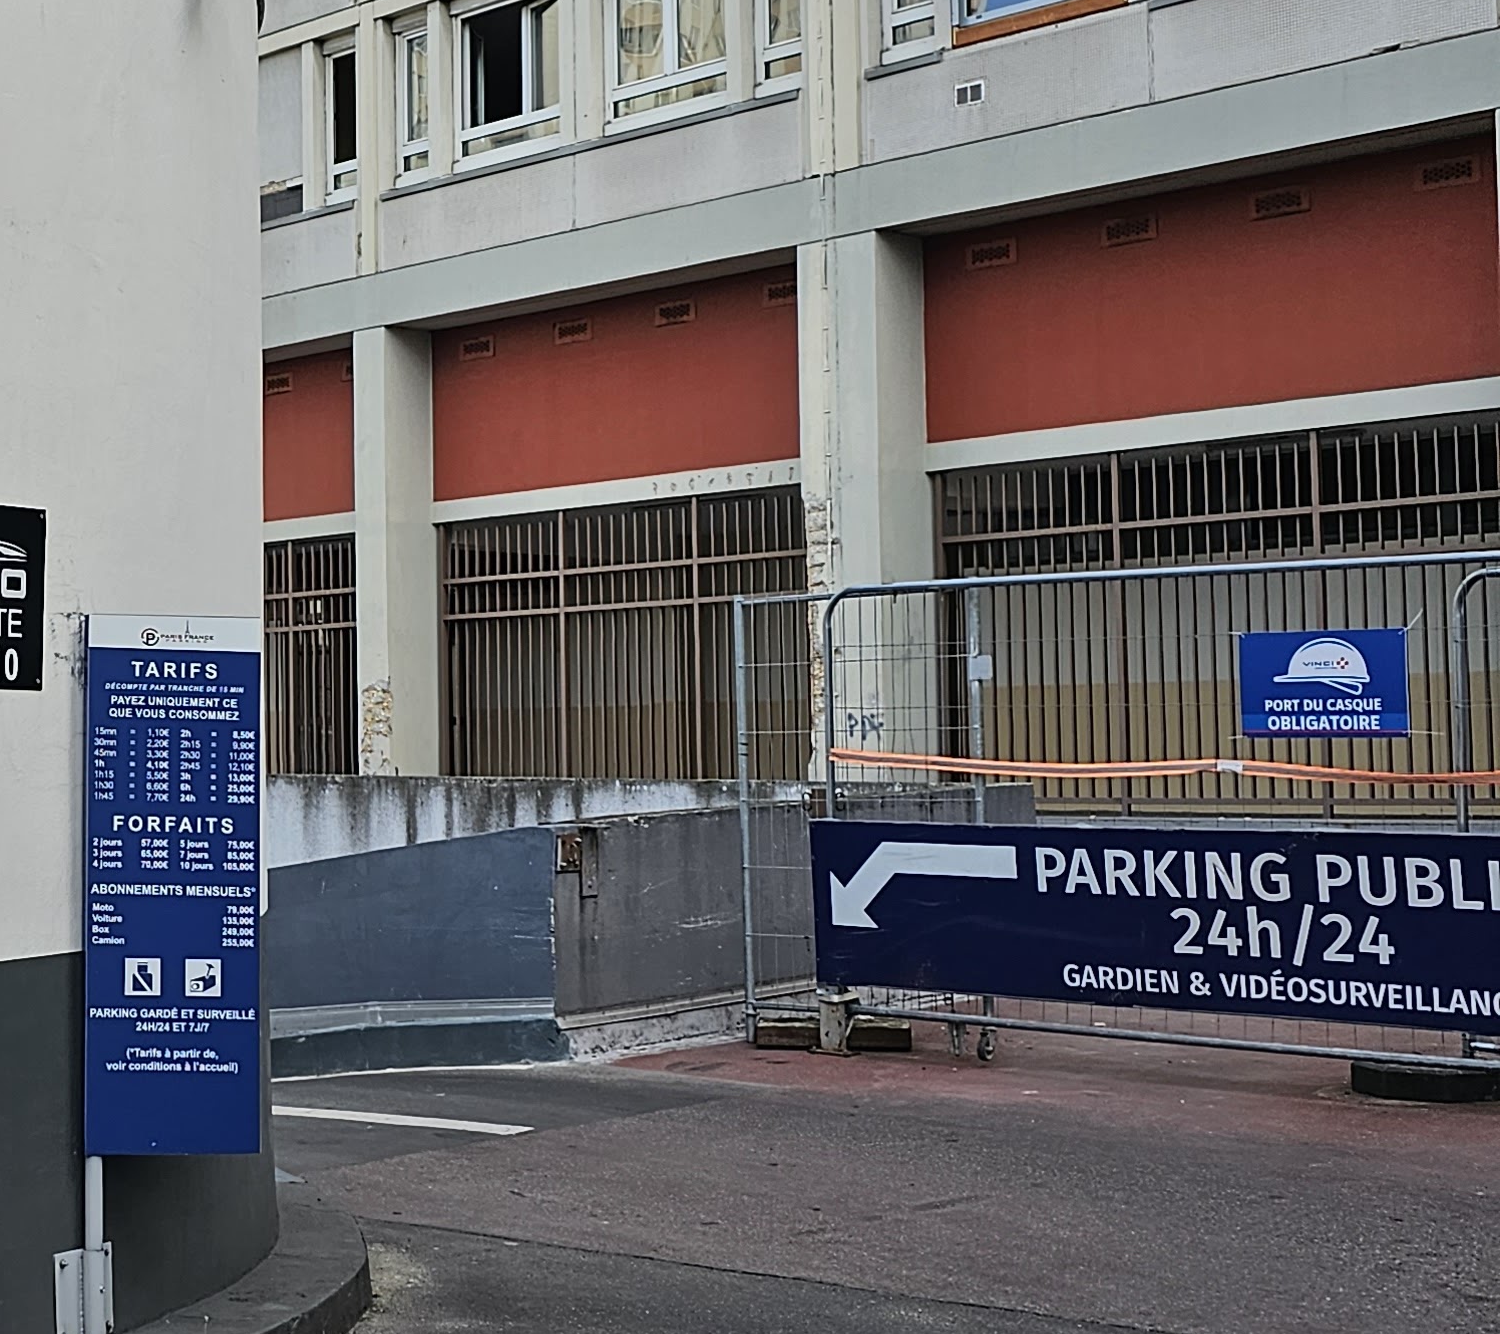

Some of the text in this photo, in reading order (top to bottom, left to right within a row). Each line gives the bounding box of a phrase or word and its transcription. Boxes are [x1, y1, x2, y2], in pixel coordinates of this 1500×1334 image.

[131, 661, 218, 680] TARIFS
[104, 682, 148, 691] DÉCOMPTE
[167, 684, 204, 693] TRANCHE
[229, 686, 244, 694] MIN
[110, 695, 238, 709] PAYEZ UNIQUEMENT CE
[1264, 698, 1382, 712] PORT DU CASQUE
[109, 707, 240, 721] QUE VOUS CONSOMMEZ
[1267, 715, 1380, 731] OBLIGATOIRE
[94, 727, 116, 736] 15mn
[146, 728, 169, 737] 1,10€
[180, 729, 191, 738] 2h
[94, 738, 116, 746] 30mn
[94, 748, 116, 757] 45mn
[229, 752, 255, 761] 11,00€
[94, 759, 105, 767] 1h
[228, 763, 255, 772] 12,10€
[94, 770, 114, 778] 1h15
[94, 792, 114, 800] 1h45
[180, 794, 196, 802] 24h
[112, 815, 234, 834] FORFAITS
[92, 838, 99, 846] 2
[99, 838, 122, 848] jours
[180, 840, 185, 848] 5
[186, 841, 209, 850] jours
[92, 849, 99, 857] 3
[99, 849, 122, 859] jours
[180, 851, 185, 859] 7
[186, 852, 209, 861] jours
[92, 860, 99, 868] 4
[99, 860, 122, 870] jours
[180, 861, 190, 869] 10
[191, 862, 214, 871] jours
[1035, 847, 1500, 911] PARKING PUBLI
[90, 884, 183, 896] ABONNEMENTS
[92, 903, 114, 912] Moto
[92, 914, 123, 923] Voiture
[92, 925, 110, 933] Box
[92, 936, 125, 945] Camion
[1063, 964, 1180, 994] GARDIEN
[1189, 971, 1211, 996] &
[89, 1007, 256, 1020] PARKING GARDÉ ET SURVEILLÉ
[135, 1021, 210, 1033] 24H/24 ET 7J/7
[164, 1048, 171, 1058] à
[173, 1048, 201, 1060] partir
[203, 1048, 219, 1060] de,
[106, 1061, 239, 1074] voir conditions à l'accueil)
